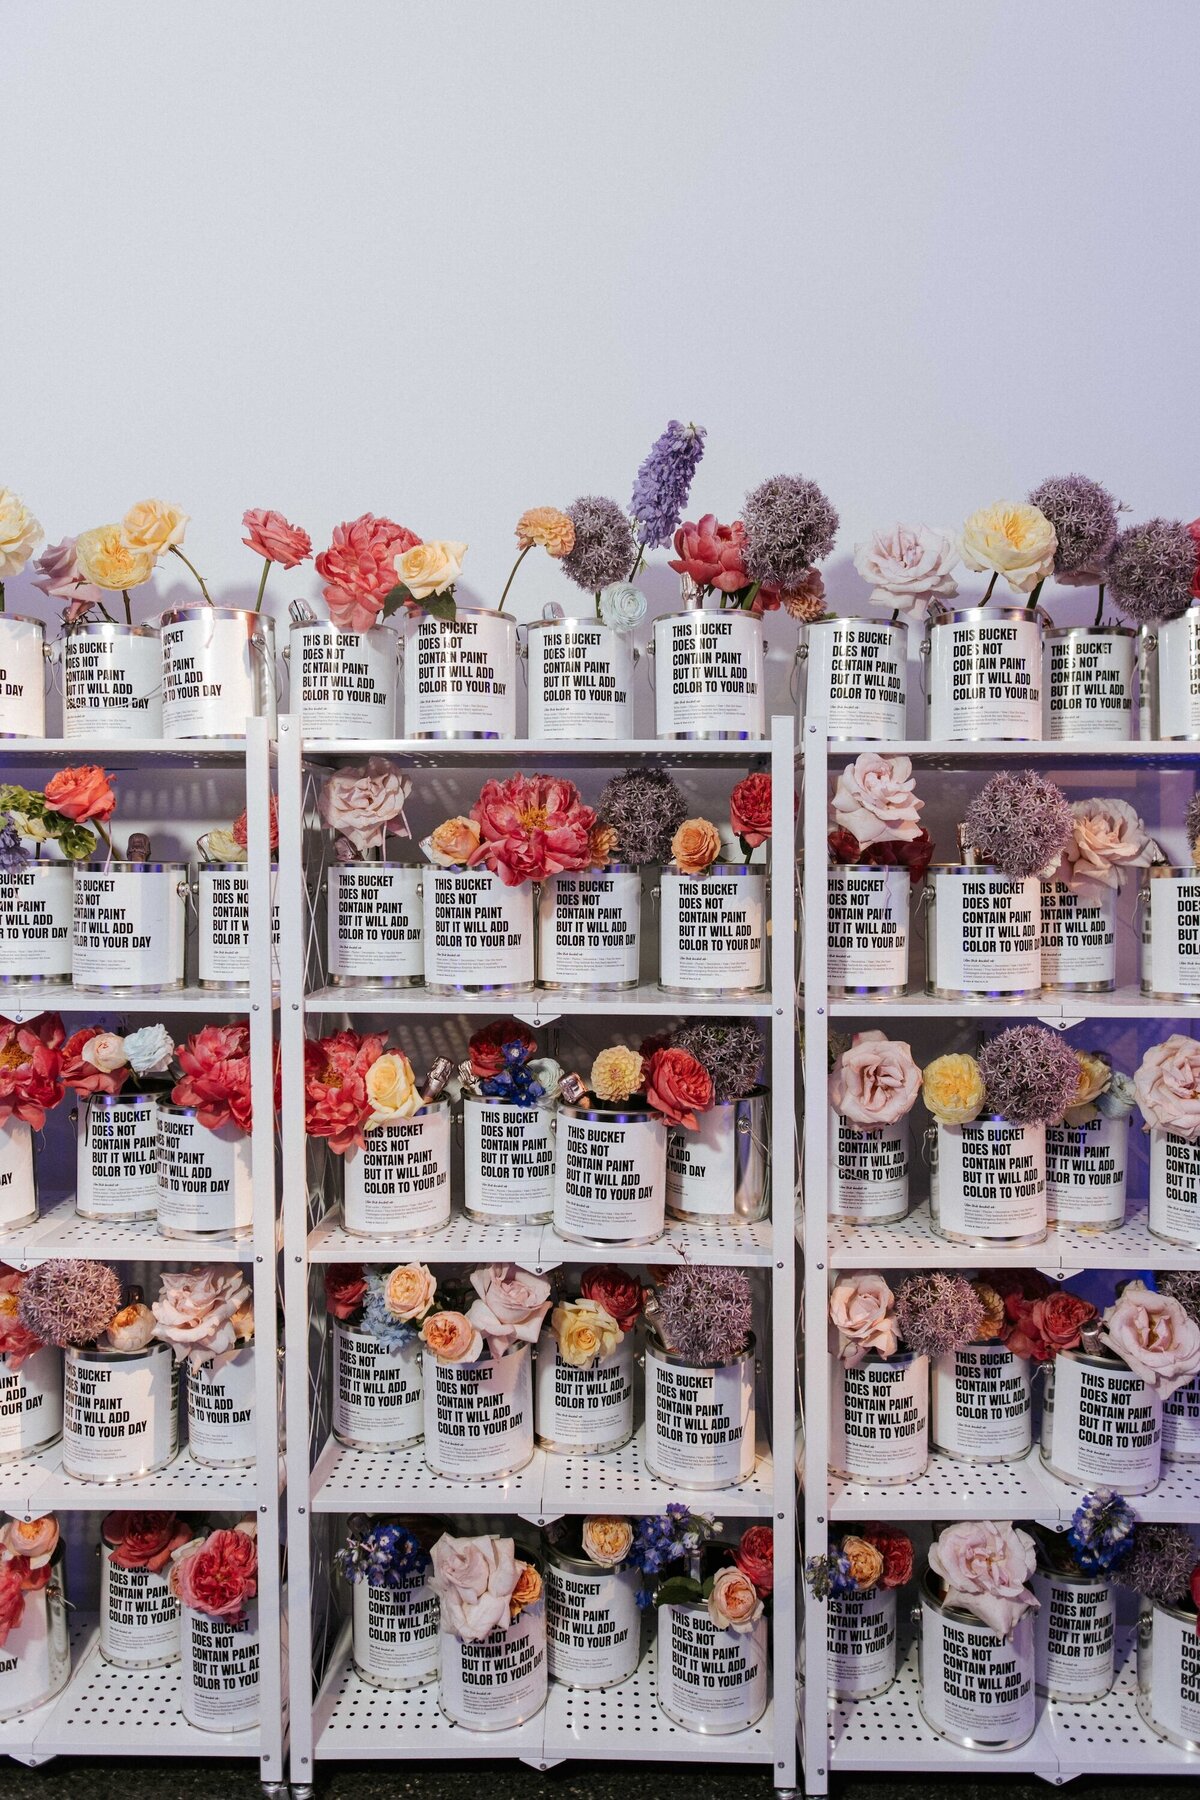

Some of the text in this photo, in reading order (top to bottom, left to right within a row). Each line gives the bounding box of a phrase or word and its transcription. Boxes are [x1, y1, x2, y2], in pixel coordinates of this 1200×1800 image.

[303, 634, 321, 647] THIS
[953, 628, 1018, 643] THIS BUCKET
[303, 649, 345, 660] DOES NOT
[953, 643, 1003, 657] DOES NOT
[173, 657, 194, 671] PAINT
[303, 662, 369, 675] CONTAIN PAINT
[953, 658, 1026, 672] CONTAIN PAINT
[184, 671, 203, 685] ADD
[303, 676, 375, 690] BUT IT WILL ADD
[953, 672, 1031, 686] BUT IT WILL ADD
[177, 684, 222, 699] YOUR DAY
[303, 690, 387, 705] COLOR TO YOUR DAY
[953, 687, 986, 700] COLOR
[989, 687, 1002, 699] TO
[1005, 687, 1028, 699] YOUR
[83, 880, 115, 892] BUCKET
[435, 878, 492, 891] THIS BUCKET
[679, 883, 738, 895] THIS BUCKET
[1177, 885, 1200, 898] THIS
[85, 894, 100, 906] NOT
[435, 893, 477, 905] DOES NOT
[679, 897, 724, 909] DOES NOT
[98, 908, 126, 920] PAINT
[435, 907, 503, 919] CONTAIN PAINT
[679, 911, 746, 923] CONTAIN PAINT
[81, 921, 134, 934] IT WILL ADD
[435, 921, 509, 933] BUT IT WILL ADD
[679, 925, 752, 937] BUT IT WILL ADD
[90, 936, 151, 948] TO YOUR DAY
[435, 934, 522, 947] COLOR TO YOUR DAY
[1178, 929, 1199, 941] BUT
[679, 937, 761, 951] COLOR TO YOUR DAY
[364, 1123, 424, 1138] THIS BUCKET
[962, 1128, 1025, 1141] THIS BUCKET
[364, 1139, 410, 1152] DOES NOT
[962, 1142, 1011, 1156] DOES NOT
[178, 1152, 205, 1165] PAINT
[363, 1149, 433, 1166] CONTAIN PAINT
[962, 1155, 1033, 1170] CONTAIN PAINT
[169, 1164, 212, 1179] WILL ADD
[364, 1162, 438, 1180] BUT IT WILL ADD
[963, 1168, 1038, 1184] BUT IT WILL ADD
[170, 1178, 230, 1193] TO YOUR DAY
[364, 1171, 447, 1194] COLOR TO YOUR DAY
[963, 1183, 1036, 1199] COLOR TO YOUR
[78, 1367, 112, 1382] BUCKET
[656, 1367, 713, 1389] THIS BUCKET
[80, 1382, 96, 1395] NOT
[656, 1381, 698, 1402] DOES NOT
[94, 1398, 122, 1410] PAINT
[657, 1395, 724, 1417] CONTAIN PAINT
[75, 1408, 130, 1424] IT WILL ADD
[657, 1409, 730, 1431] BUT IT WILL ADD
[84, 1420, 147, 1438] TO YOUR DAY
[656, 1423, 743, 1445] COLOR TO YOUR DAY
[672, 1609, 729, 1632] THIS BUC
[672, 1623, 715, 1646] DOES NOT
[942, 1624, 965, 1643] THIS
[672, 1637, 740, 1660] CONTAIN PAINT
[943, 1639, 992, 1662] DOES NOT
[672, 1651, 746, 1674] BUT IT WILL ADD
[943, 1653, 1016, 1676] CONTAIN PAINT
[672, 1664, 758, 1688] COLOR TO YOUR DAY
[943, 1667, 1022, 1690] BUT IT WILL ADD
[943, 1679, 1031, 1704] COLOR TO YOUR DAY
